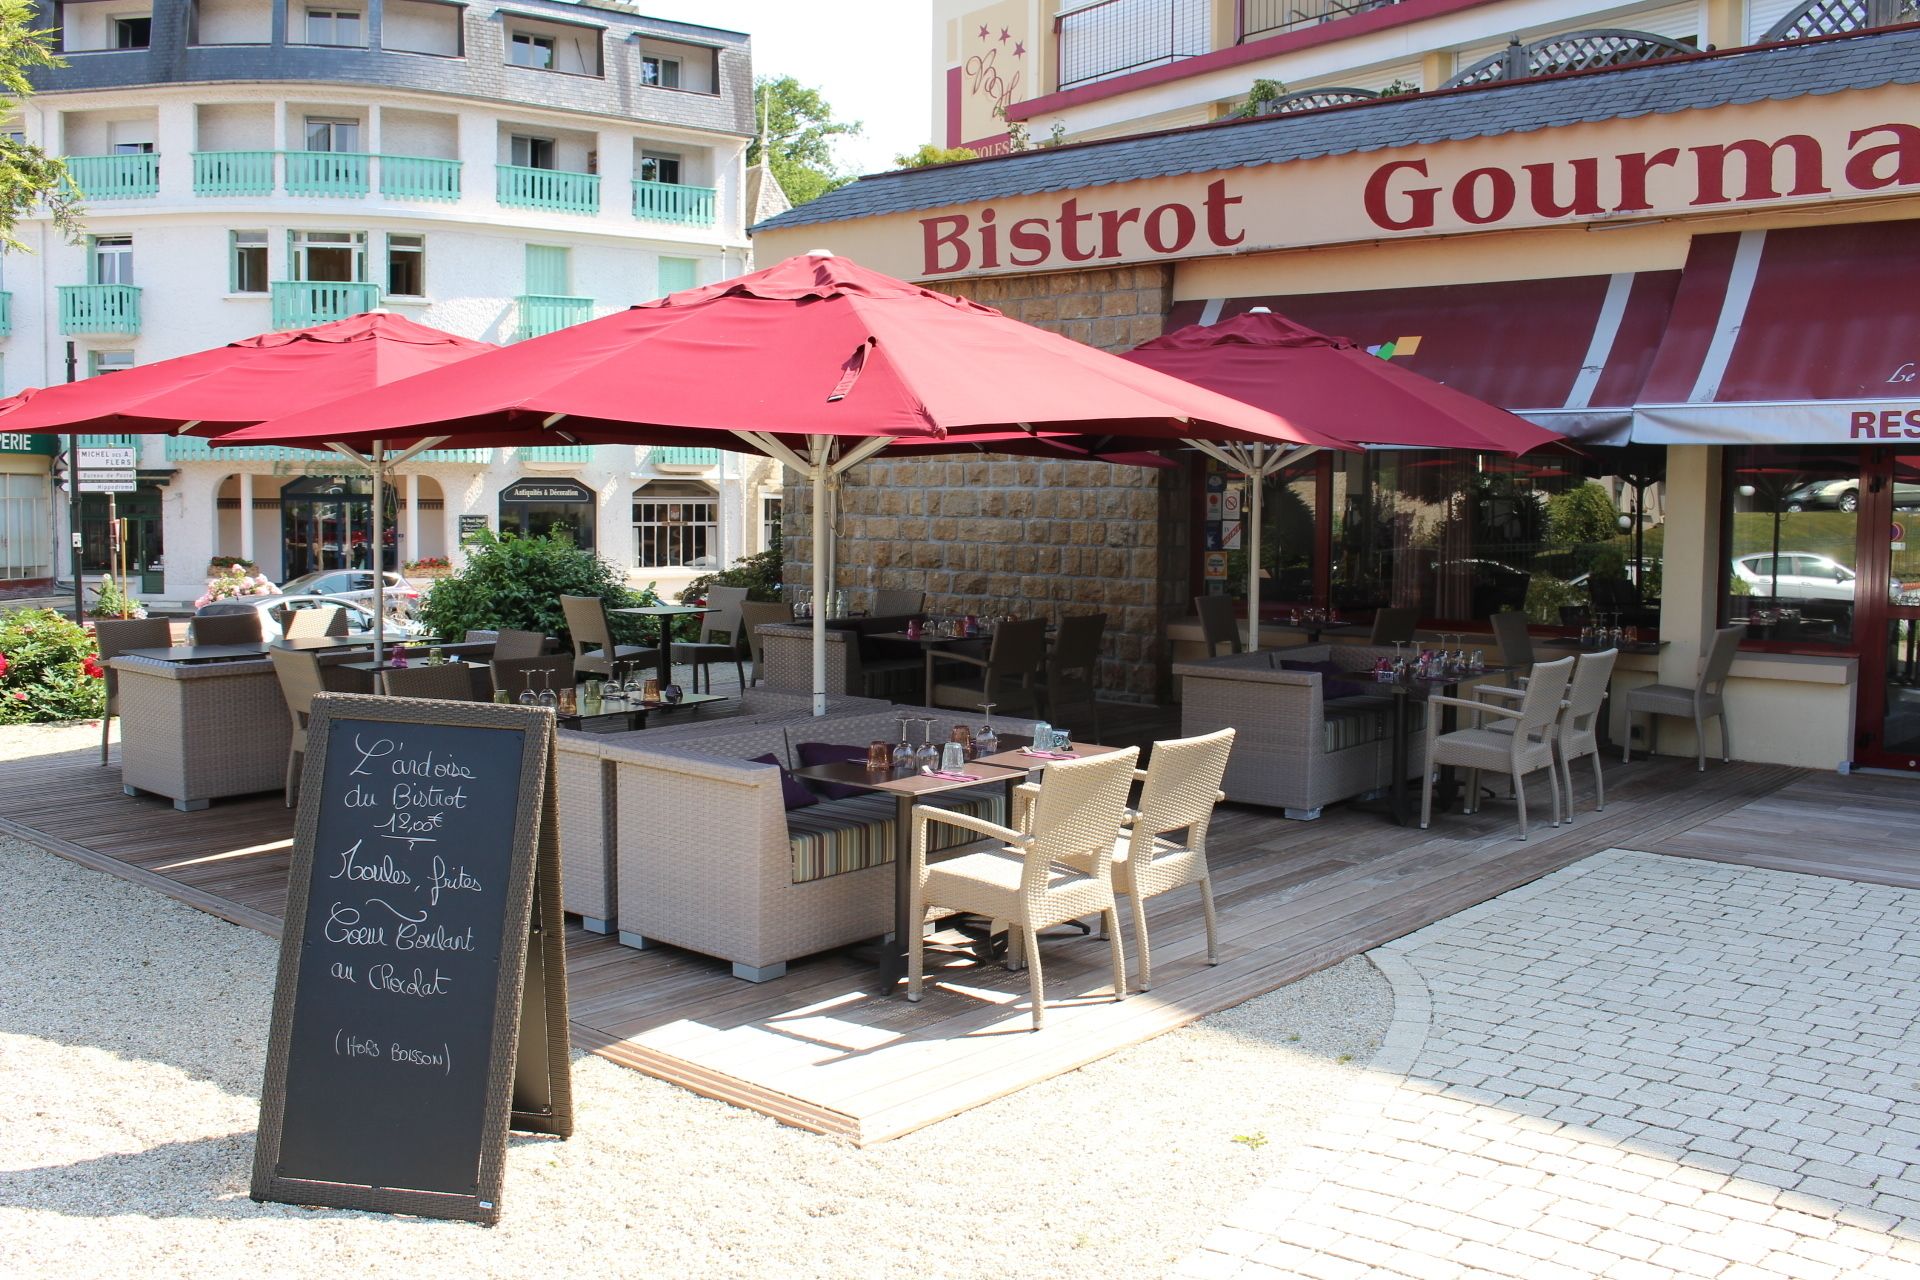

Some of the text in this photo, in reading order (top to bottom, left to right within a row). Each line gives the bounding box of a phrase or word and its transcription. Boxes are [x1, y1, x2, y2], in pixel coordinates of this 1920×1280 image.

[974, 140, 1010, 158] NOLES
[918, 123, 1920, 276] Bistrot Gourma
[1885, 363, 1916, 383] Le
[1850, 409, 1920, 439] RES
[0, 432, 32, 450] ERIE
[514, 488, 543, 498] Antiquités
[549, 488, 579, 496] Décoration
[350, 732, 477, 779] L'ardoise
[344, 782, 468, 810] du Bistrot
[427, 855, 482, 906] frites
[396, 922, 475, 951] Coulant
[331, 962, 452, 997] au Chocolat
